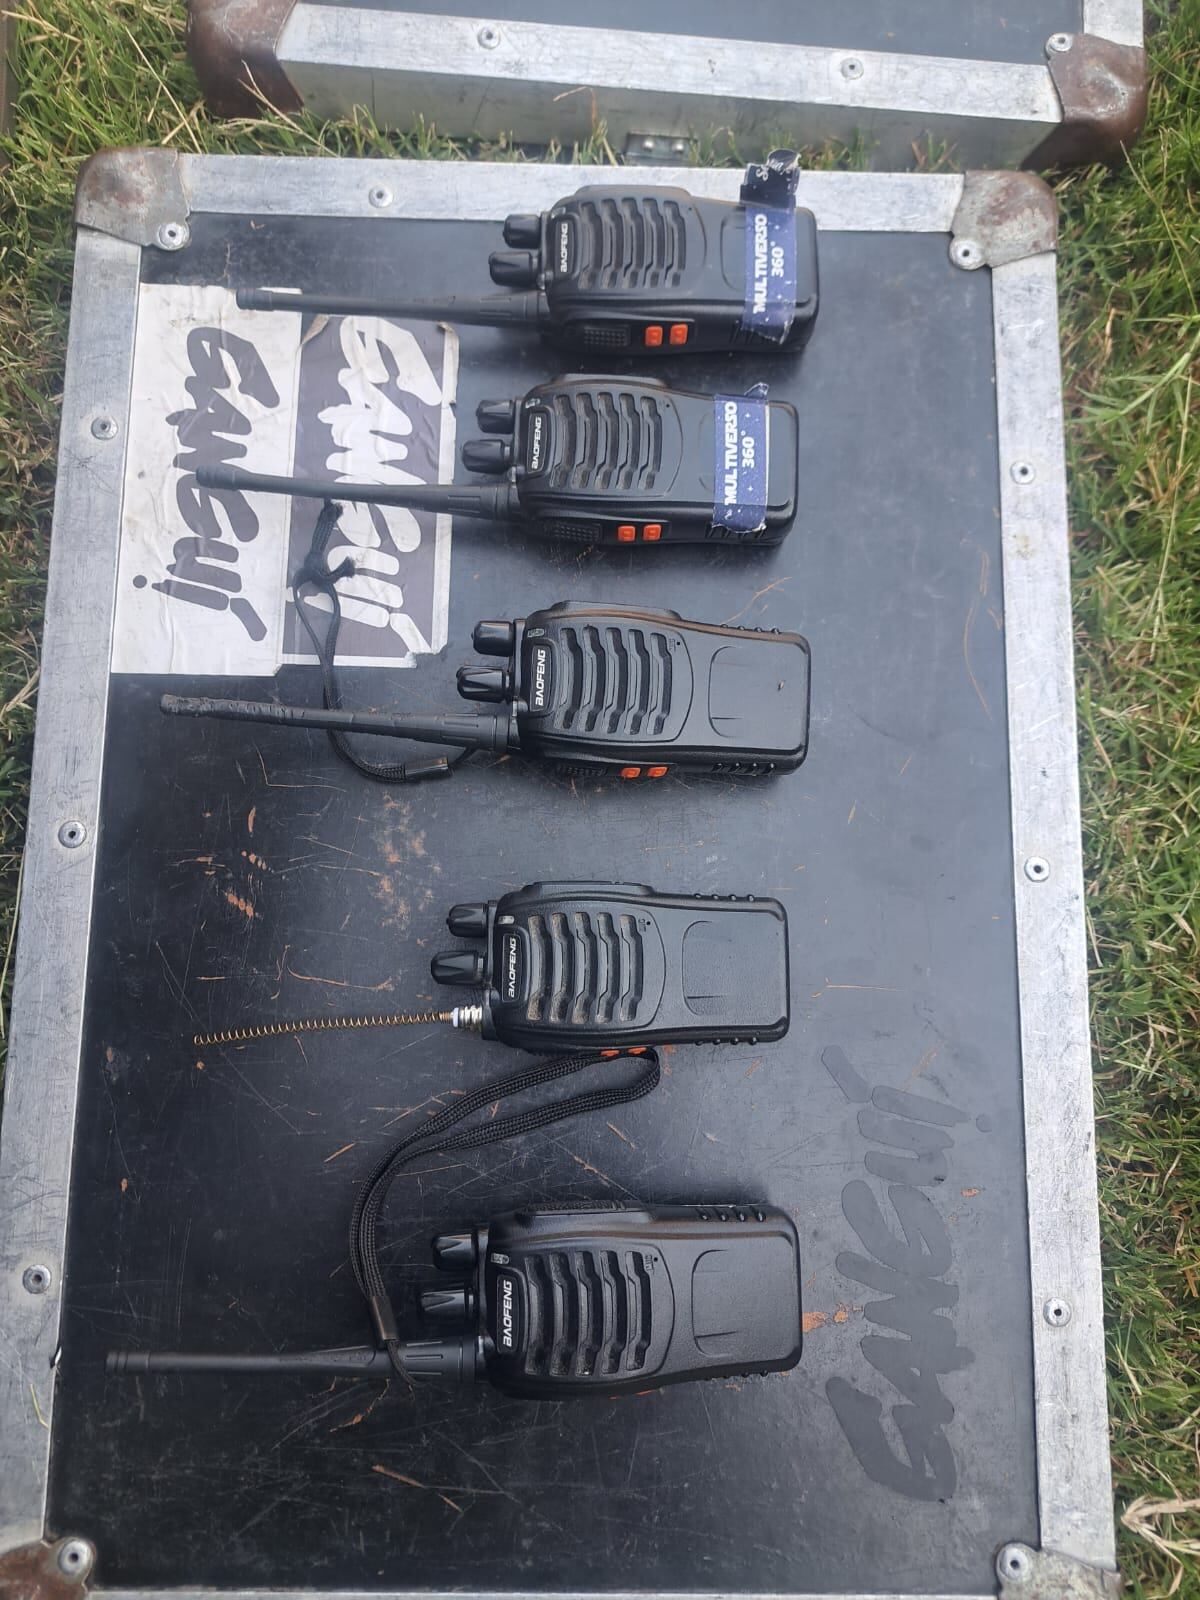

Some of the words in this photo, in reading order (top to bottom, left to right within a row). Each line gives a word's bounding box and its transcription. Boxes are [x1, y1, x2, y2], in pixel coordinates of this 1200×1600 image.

[752, 214, 768, 314] MULTIVERSO
[532, 417, 542, 470] BAOFENG
[724, 402, 738, 506] MULTIVERSO
[535, 649, 546, 706] BAOFENG
[508, 938, 518, 998] BAOFENG
[502, 1280, 513, 1348] BAOFENG
